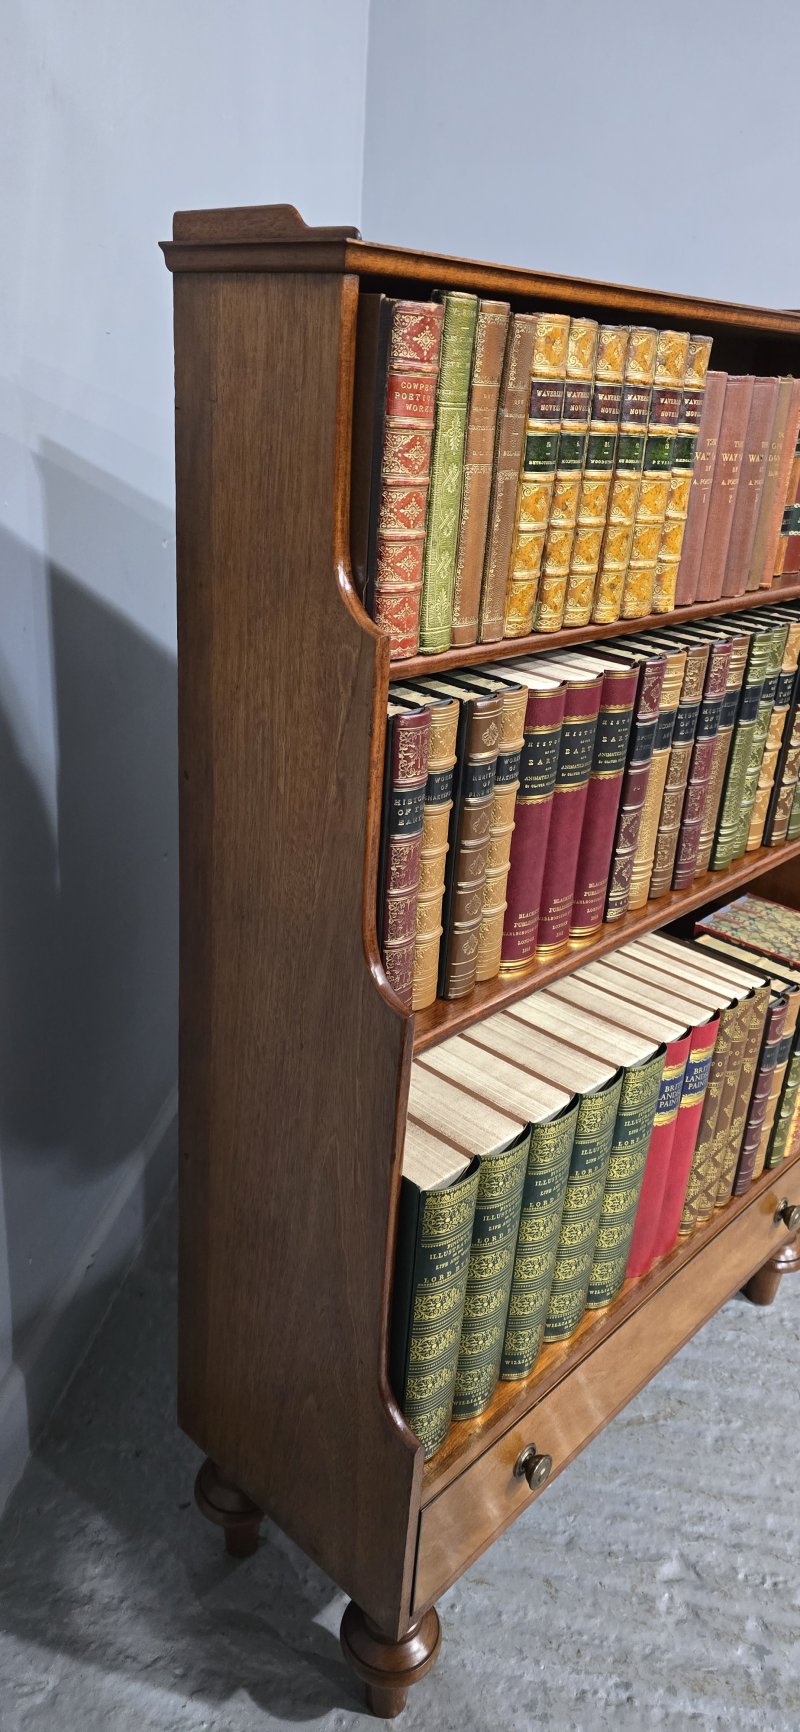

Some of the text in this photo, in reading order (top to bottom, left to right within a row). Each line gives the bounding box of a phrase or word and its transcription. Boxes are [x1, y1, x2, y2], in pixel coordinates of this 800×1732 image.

[397, 808, 412, 816] OF
[529, 1197, 554, 1208] LORD
[477, 1233, 504, 1243] LORD
[424, 1270, 452, 1283] LORD
